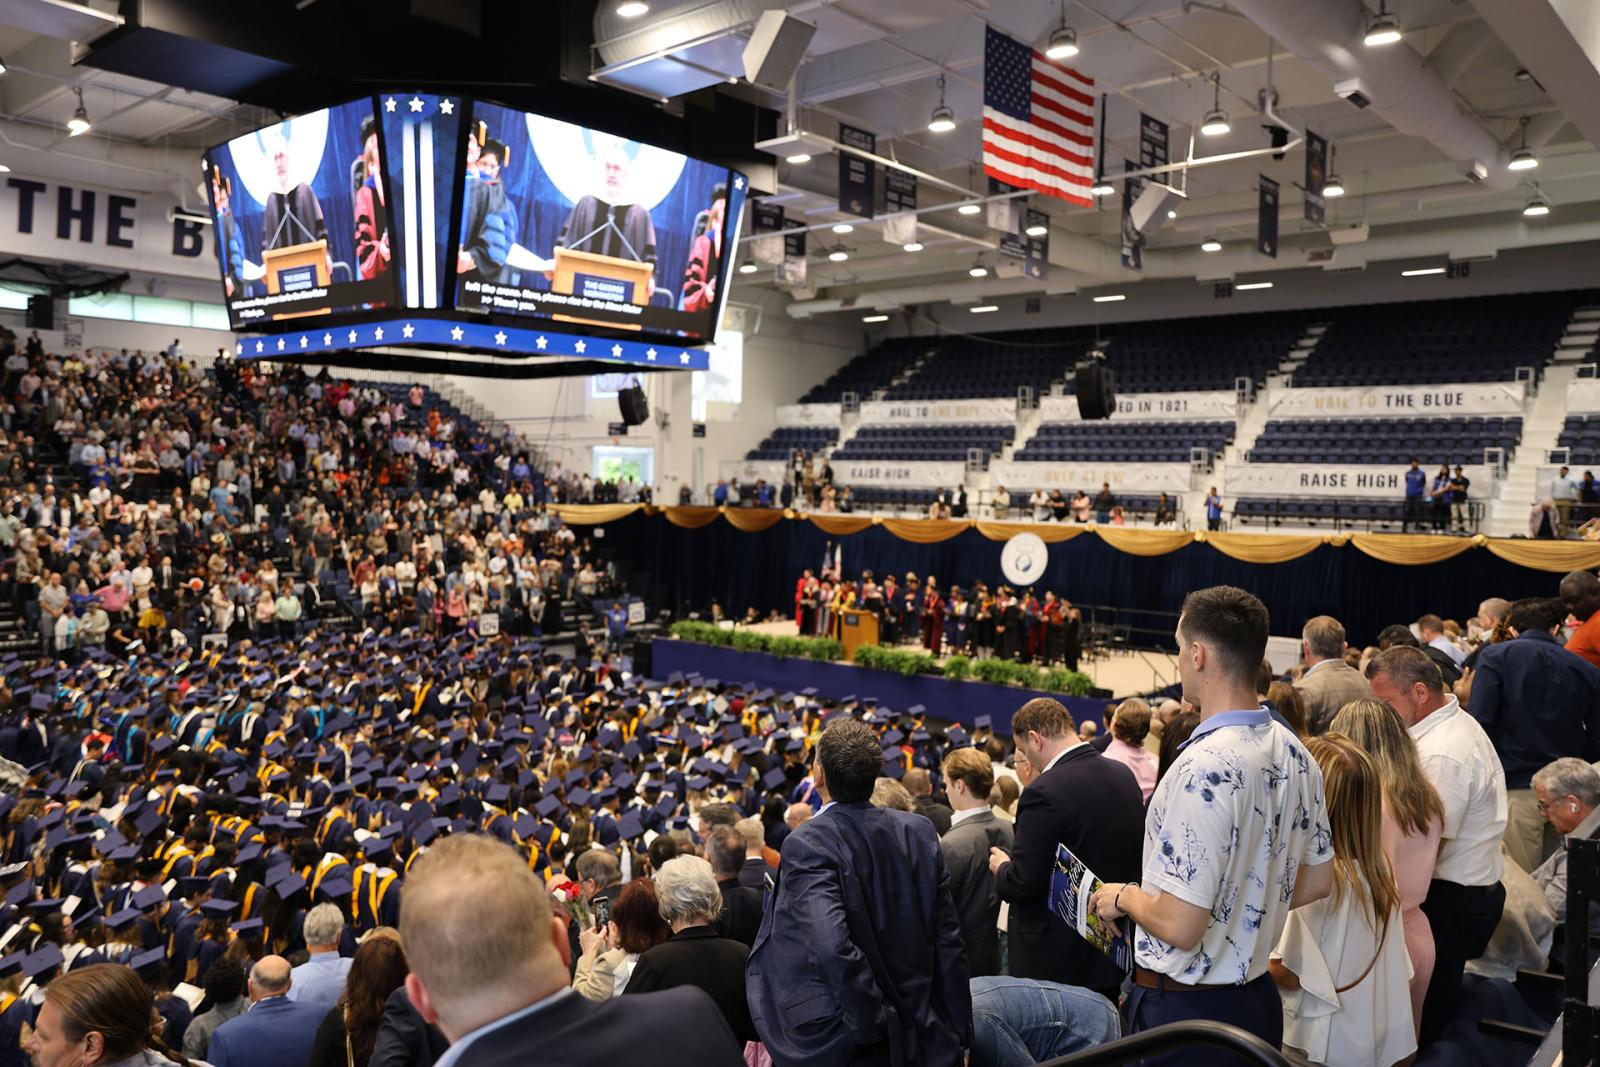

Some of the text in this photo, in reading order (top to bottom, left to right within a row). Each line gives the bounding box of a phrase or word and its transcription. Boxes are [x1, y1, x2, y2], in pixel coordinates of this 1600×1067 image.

[7, 177, 219, 259] THE B
[1138, 401, 1151, 412] IN
[1159, 400, 1189, 412] 1821
[1314, 392, 1464, 410] HAIL TO THE BLUE
[1300, 472, 1399, 489] RAISE HIGH
